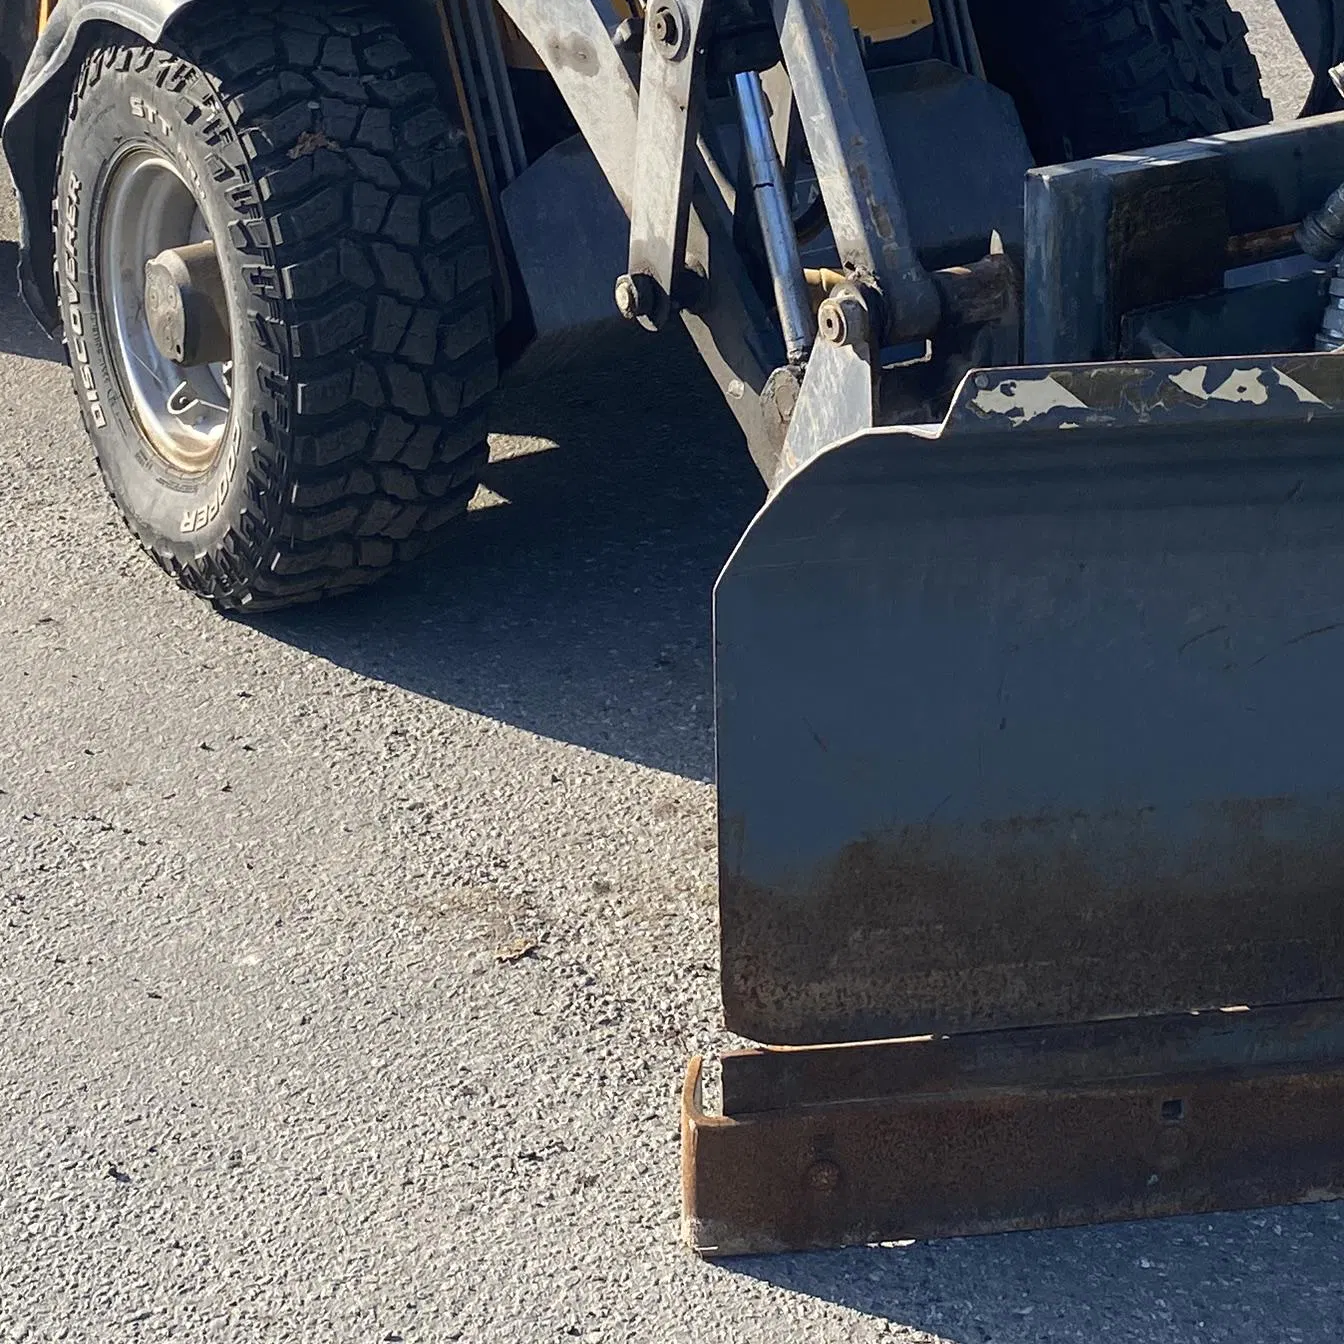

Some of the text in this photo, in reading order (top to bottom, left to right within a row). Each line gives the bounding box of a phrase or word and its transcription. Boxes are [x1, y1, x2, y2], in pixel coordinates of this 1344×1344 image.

[129, 94, 172, 137] STT
[63, 170, 107, 429] DISCOVERER
[179, 417, 242, 534] COOPER
